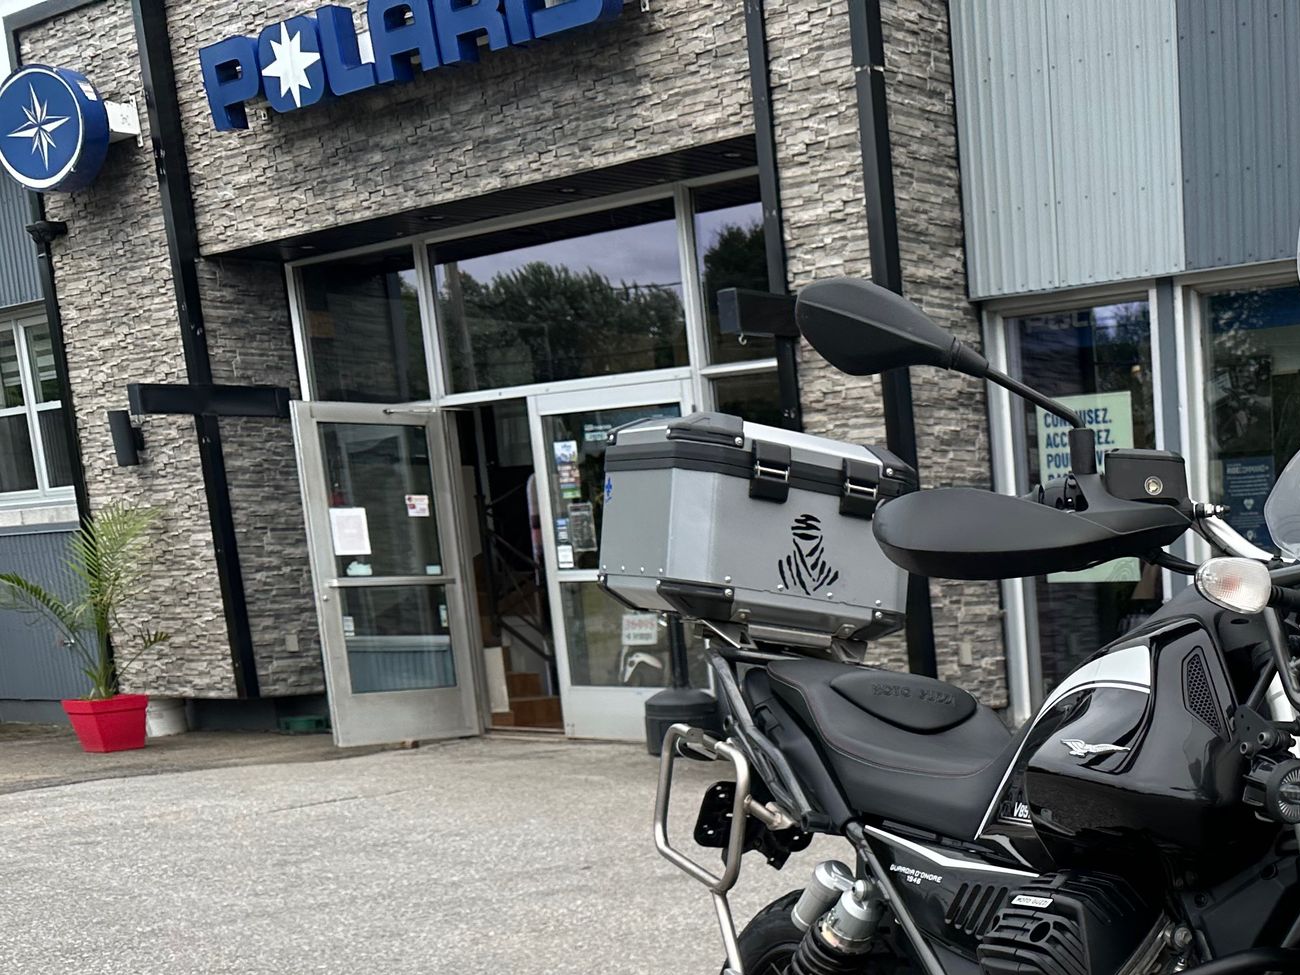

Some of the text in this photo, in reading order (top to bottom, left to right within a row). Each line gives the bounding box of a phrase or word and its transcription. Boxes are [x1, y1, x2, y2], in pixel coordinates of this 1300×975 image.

[1044, 407, 1112, 428] CONUISEZ.
[1047, 453, 1072, 469] POU
[1013, 801, 1031, 819] V85
[907, 875, 922, 885] 1946
